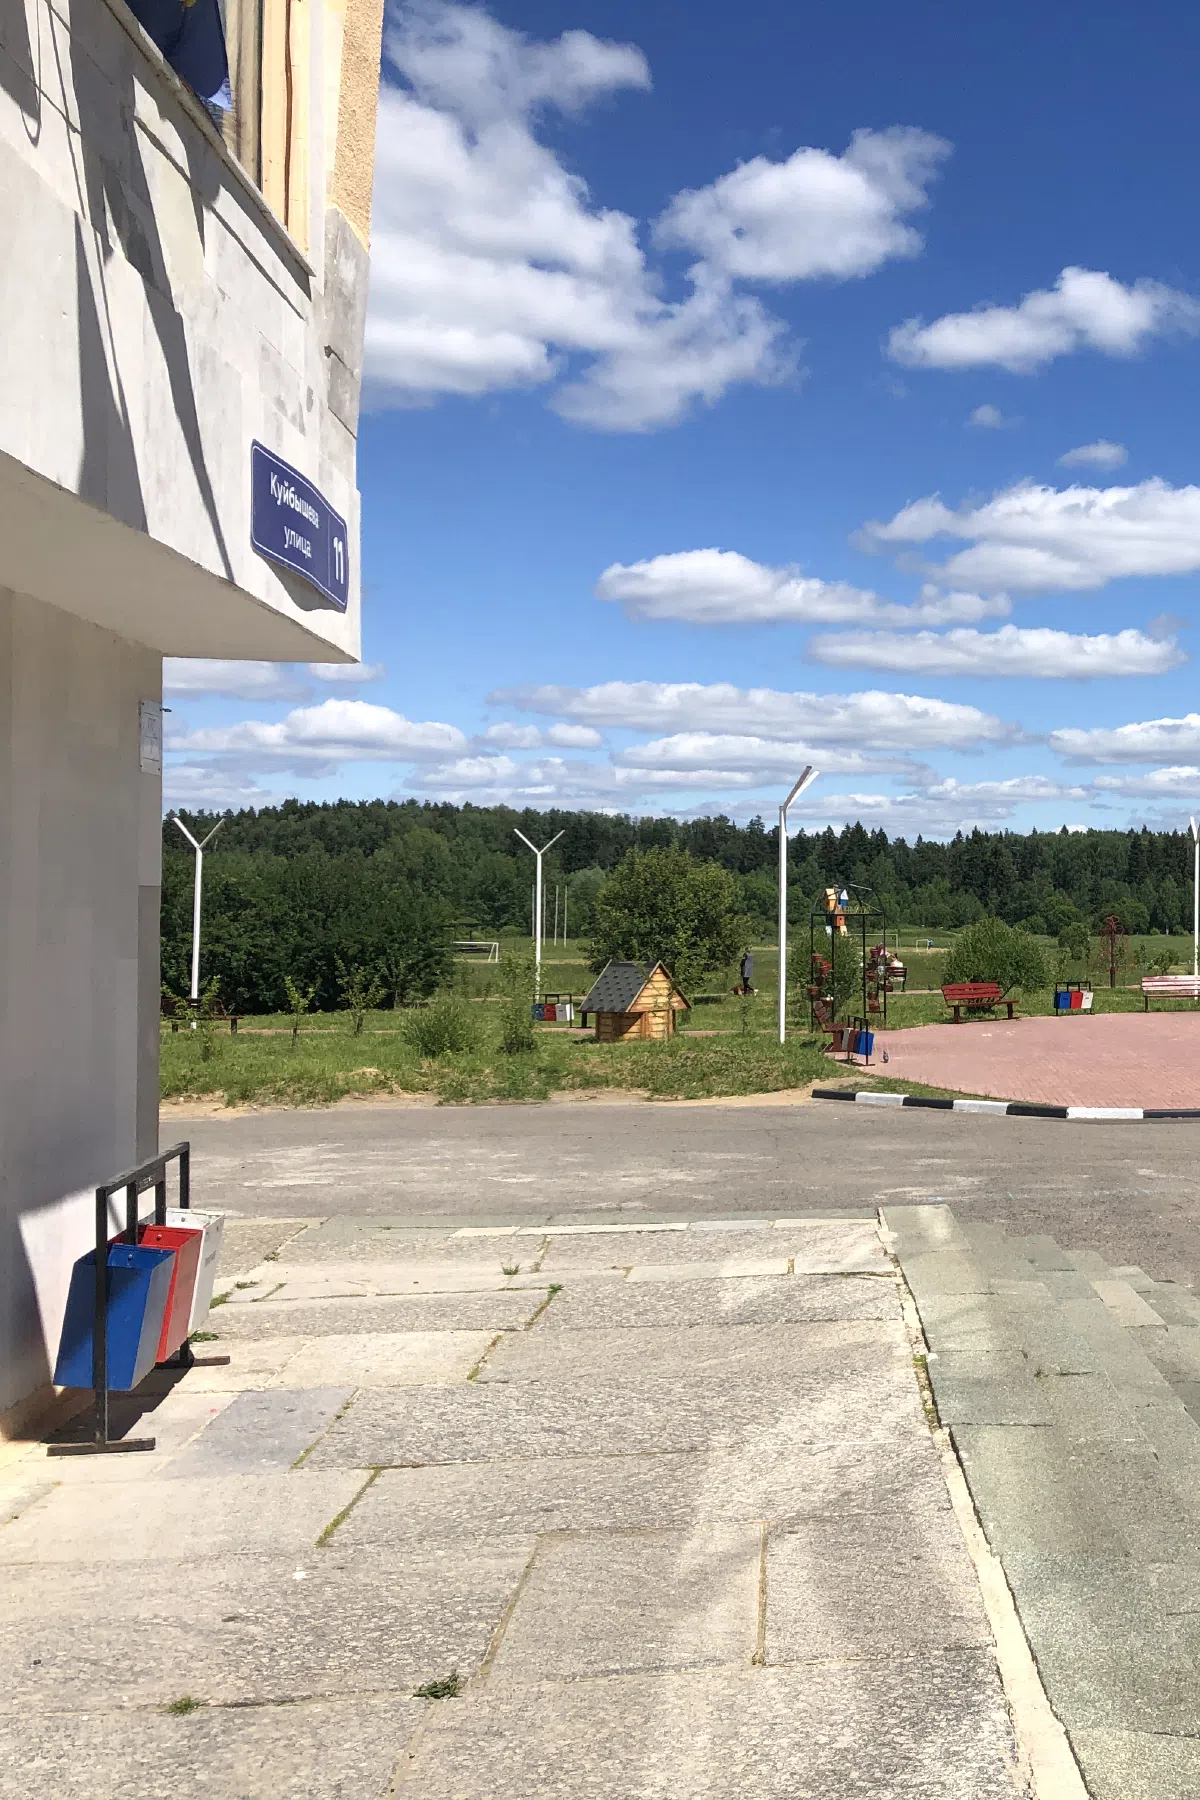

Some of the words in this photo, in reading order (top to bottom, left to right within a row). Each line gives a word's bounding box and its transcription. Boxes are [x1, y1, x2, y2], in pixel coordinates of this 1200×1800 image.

[270, 471, 319, 529] Куйбышева
[284, 525, 312, 559] улица
[333, 536, 344, 585] 11
